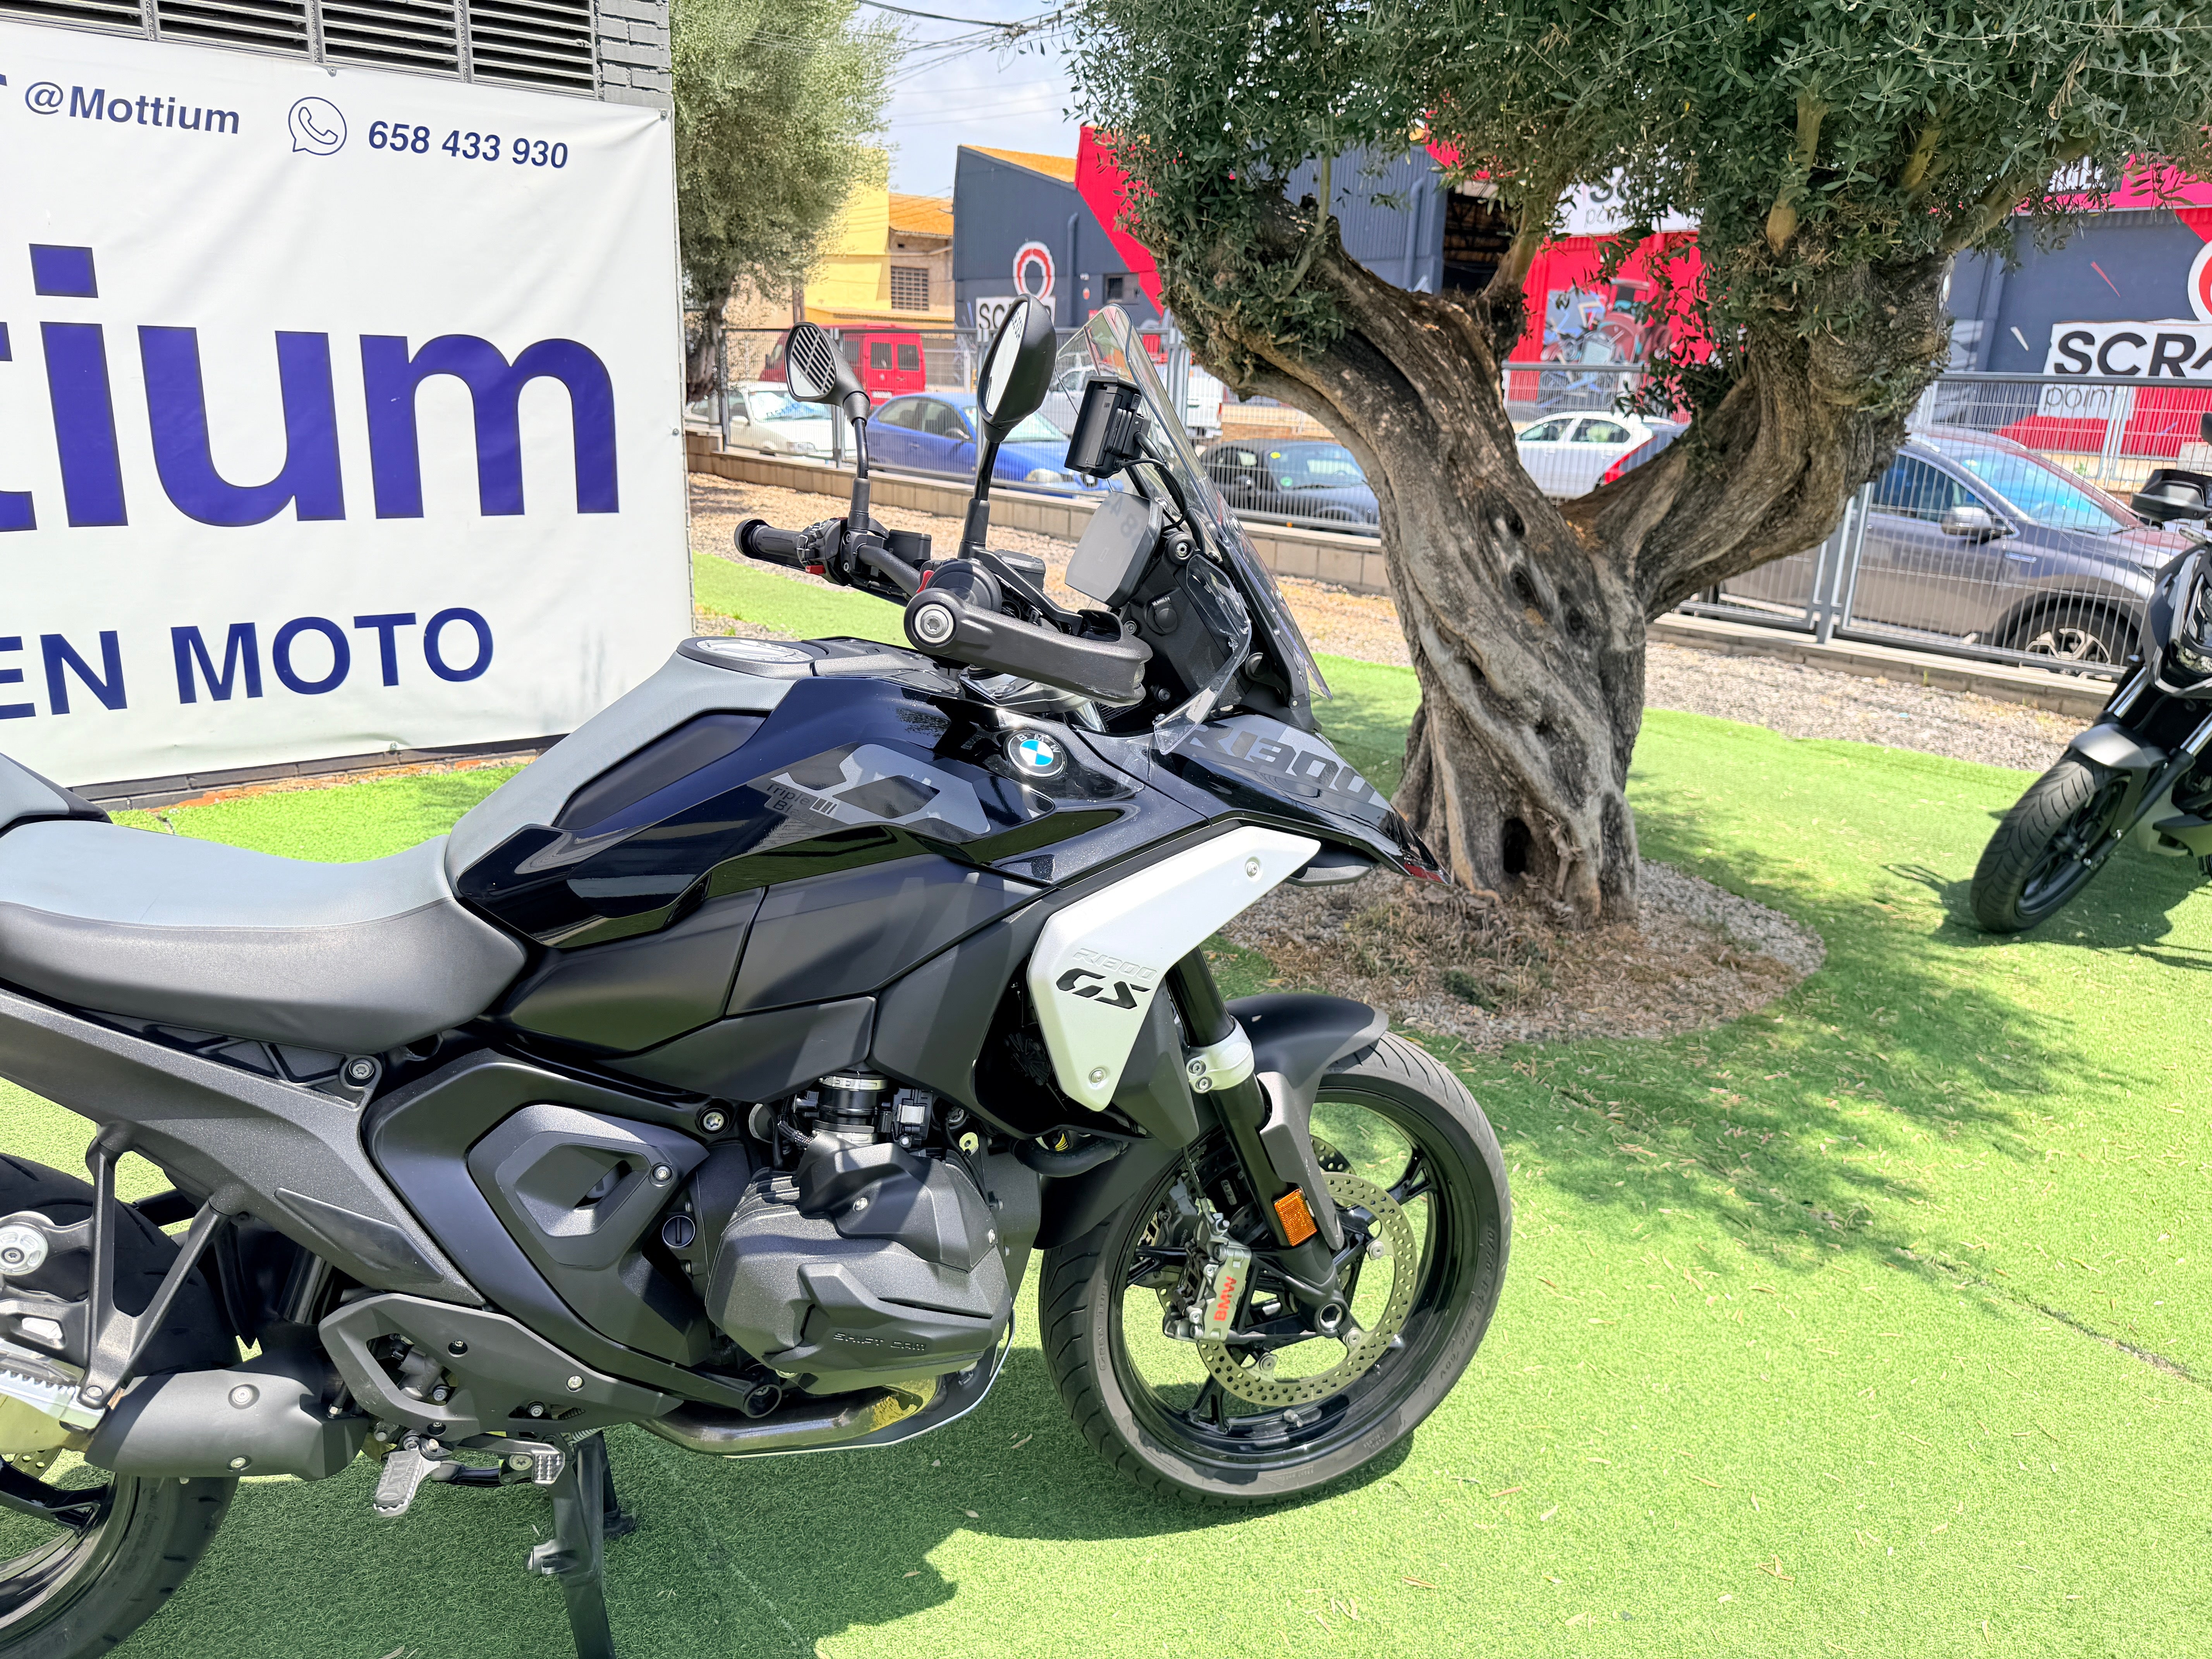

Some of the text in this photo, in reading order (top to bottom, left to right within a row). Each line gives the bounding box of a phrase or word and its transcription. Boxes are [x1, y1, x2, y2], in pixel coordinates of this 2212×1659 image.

[25, 81, 239, 134] @Mottium
[369, 121, 568, 169] 658 433 930
[2044, 387, 2116, 412] poin
[171, 607, 493, 704] MOTO
[1016, 733, 1061, 753] BMW
[767, 783, 811, 805] Triple
[773, 799, 817, 823] Black
[1073, 948, 1158, 982] R1300
[1056, 968, 1152, 1010] GS
[1213, 1276, 1237, 1322] BMW
[833, 1332, 927, 1351] SHIFT CAM
